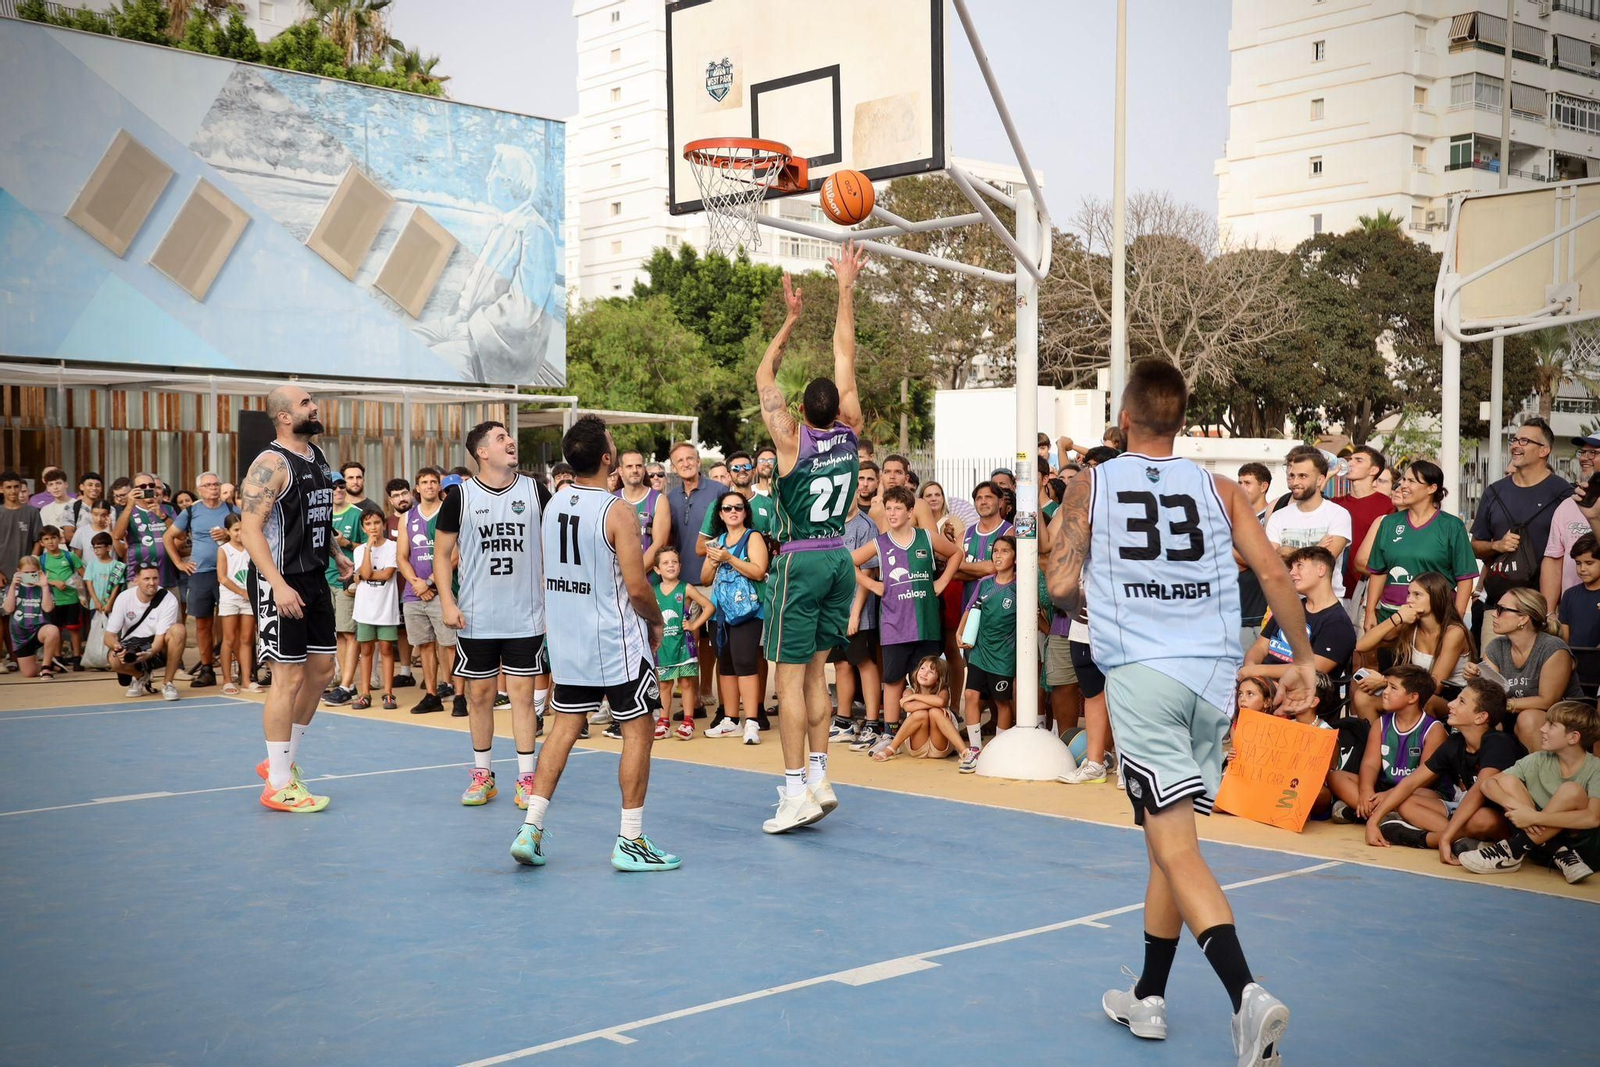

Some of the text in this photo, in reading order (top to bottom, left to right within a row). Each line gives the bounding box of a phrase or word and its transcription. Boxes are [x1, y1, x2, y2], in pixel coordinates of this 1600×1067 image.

[825, 179, 841, 215] Wilson
[817, 433, 848, 453] DURTE
[307, 489, 333, 506] WEST
[810, 472, 851, 522] 27
[478, 523, 525, 538] WEST
[1116, 491, 1205, 561] 33
[312, 527, 326, 548] 20
[481, 539, 524, 554] PARK
[558, 512, 581, 566] 11
[490, 557, 513, 575] 23
[907, 571, 929, 579] Unicaja
[898, 589, 927, 600] málaga
[1242, 721, 1293, 748] CHRIS
[1239, 742, 1288, 769] HAZME
[1229, 762, 1245, 778] EN
[1250, 767, 1263, 781] LA
[1390, 766, 1416, 776] Unic
